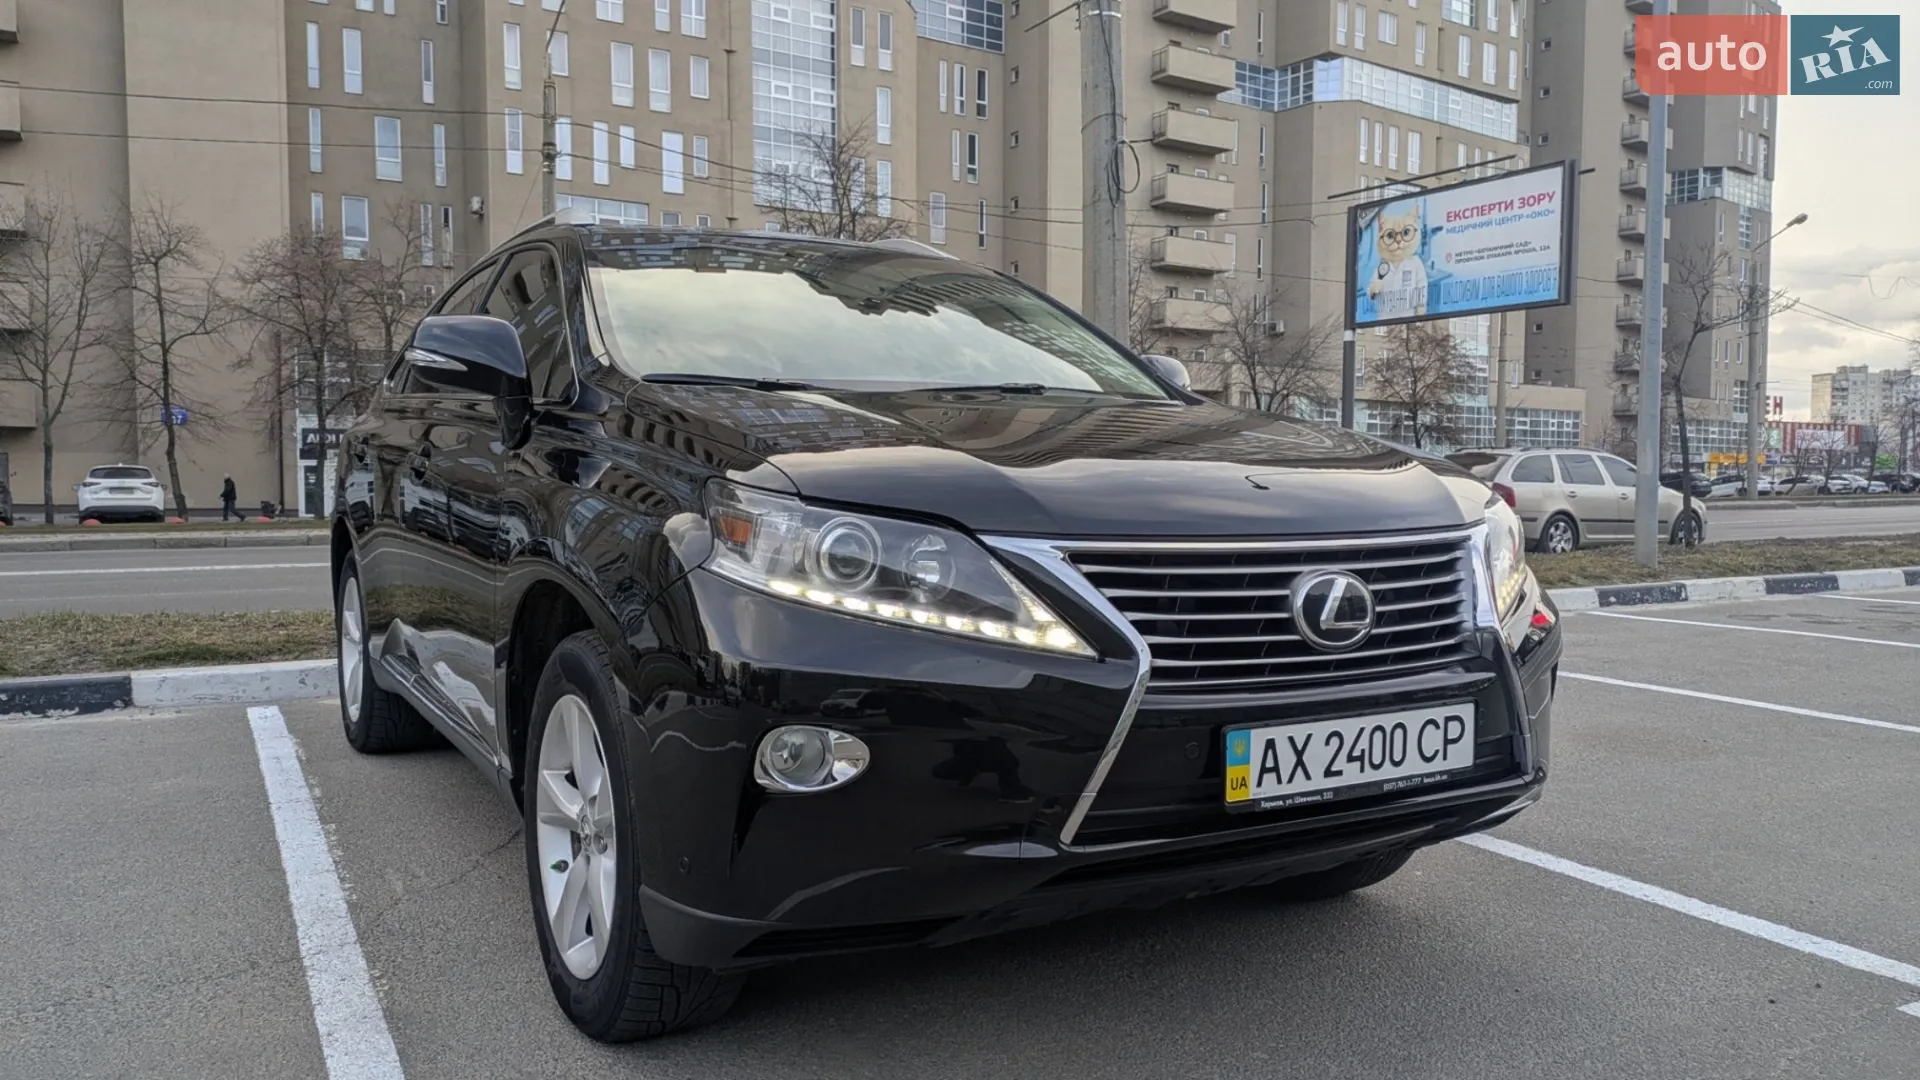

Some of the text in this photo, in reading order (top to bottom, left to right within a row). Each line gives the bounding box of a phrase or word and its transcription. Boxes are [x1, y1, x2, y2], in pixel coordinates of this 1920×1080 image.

[1446, 190, 1556, 223] ЕКСПЕРТИ ЗОРУ
[1445, 219, 1493, 235] МЕДИЧНИЙ
[1495, 214, 1524, 227] ЦЕНТР
[1256, 714, 1466, 788] AX 2400 CP
[1230, 775, 1248, 791] UA
